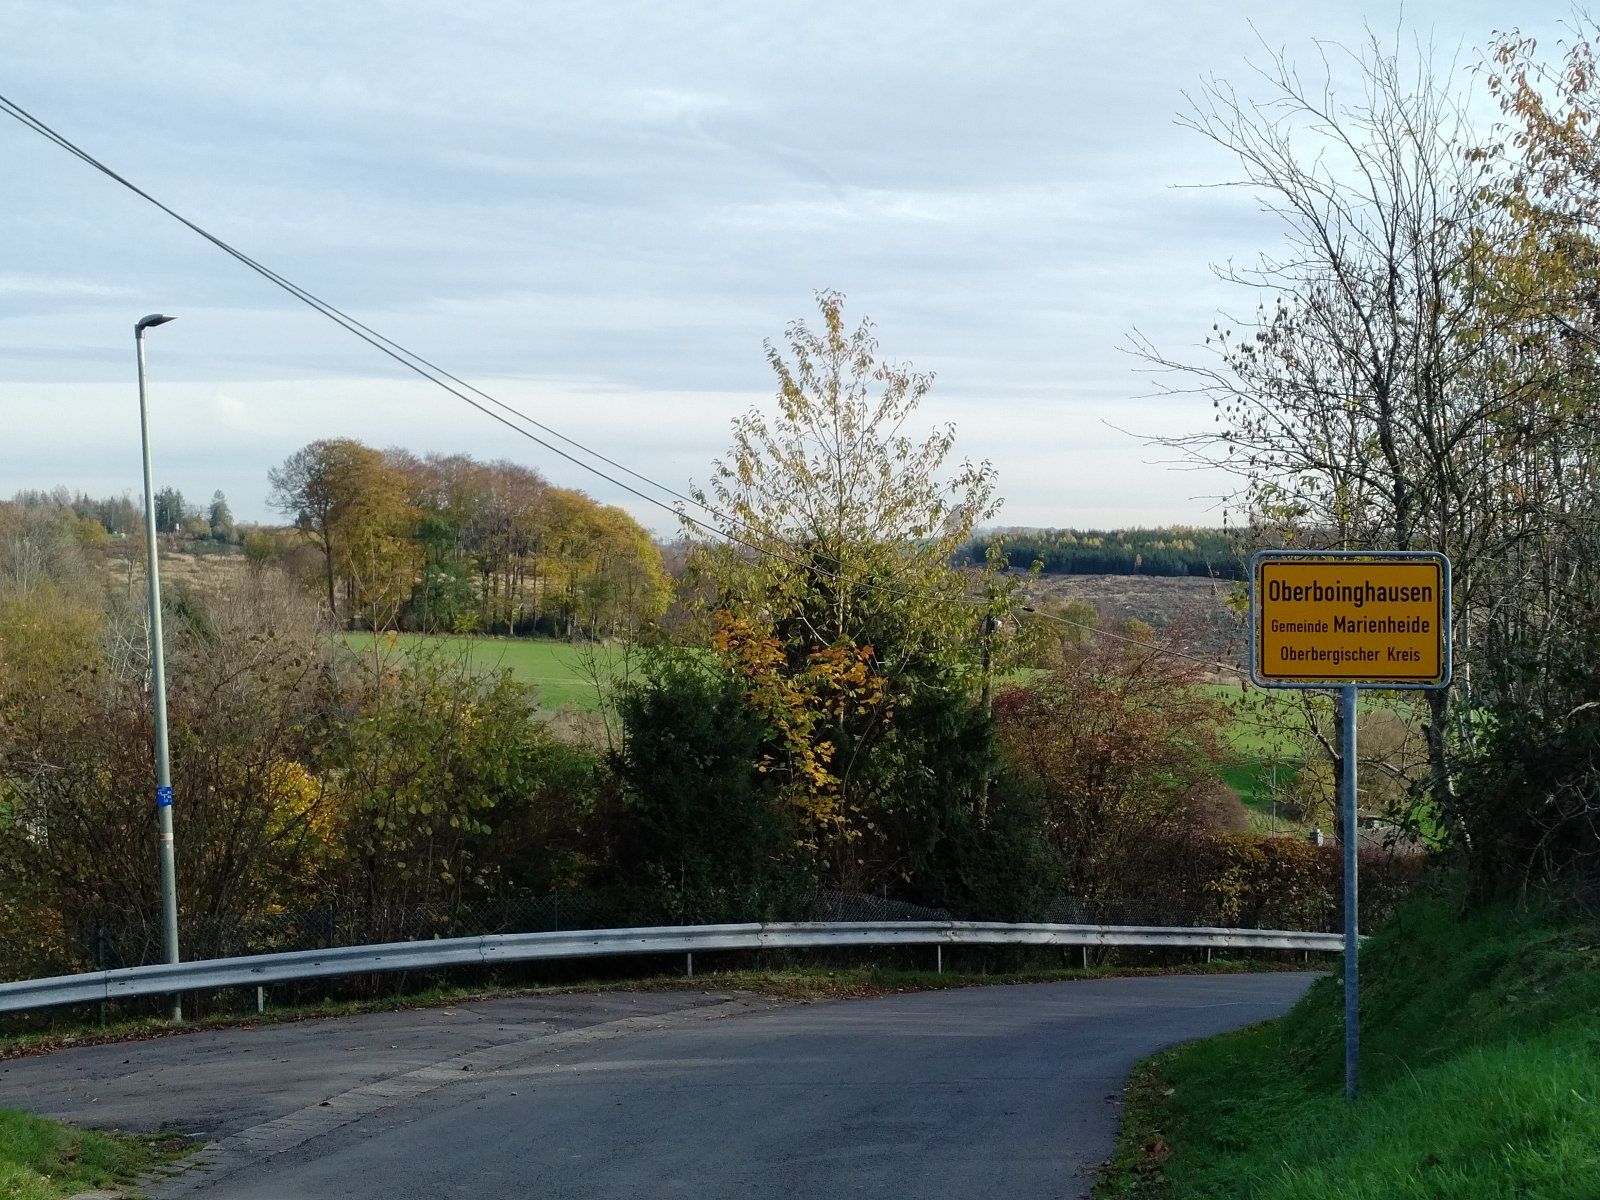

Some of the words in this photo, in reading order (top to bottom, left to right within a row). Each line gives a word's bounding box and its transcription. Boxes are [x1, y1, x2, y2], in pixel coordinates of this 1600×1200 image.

[1268, 579, 1433, 608] Oberboinghausen
[1271, 619, 1329, 633] Gemeinde
[1333, 615, 1430, 633] Marienheide
[1280, 646, 1381, 665] Oberbergischer
[1387, 646, 1421, 662] Kreis
